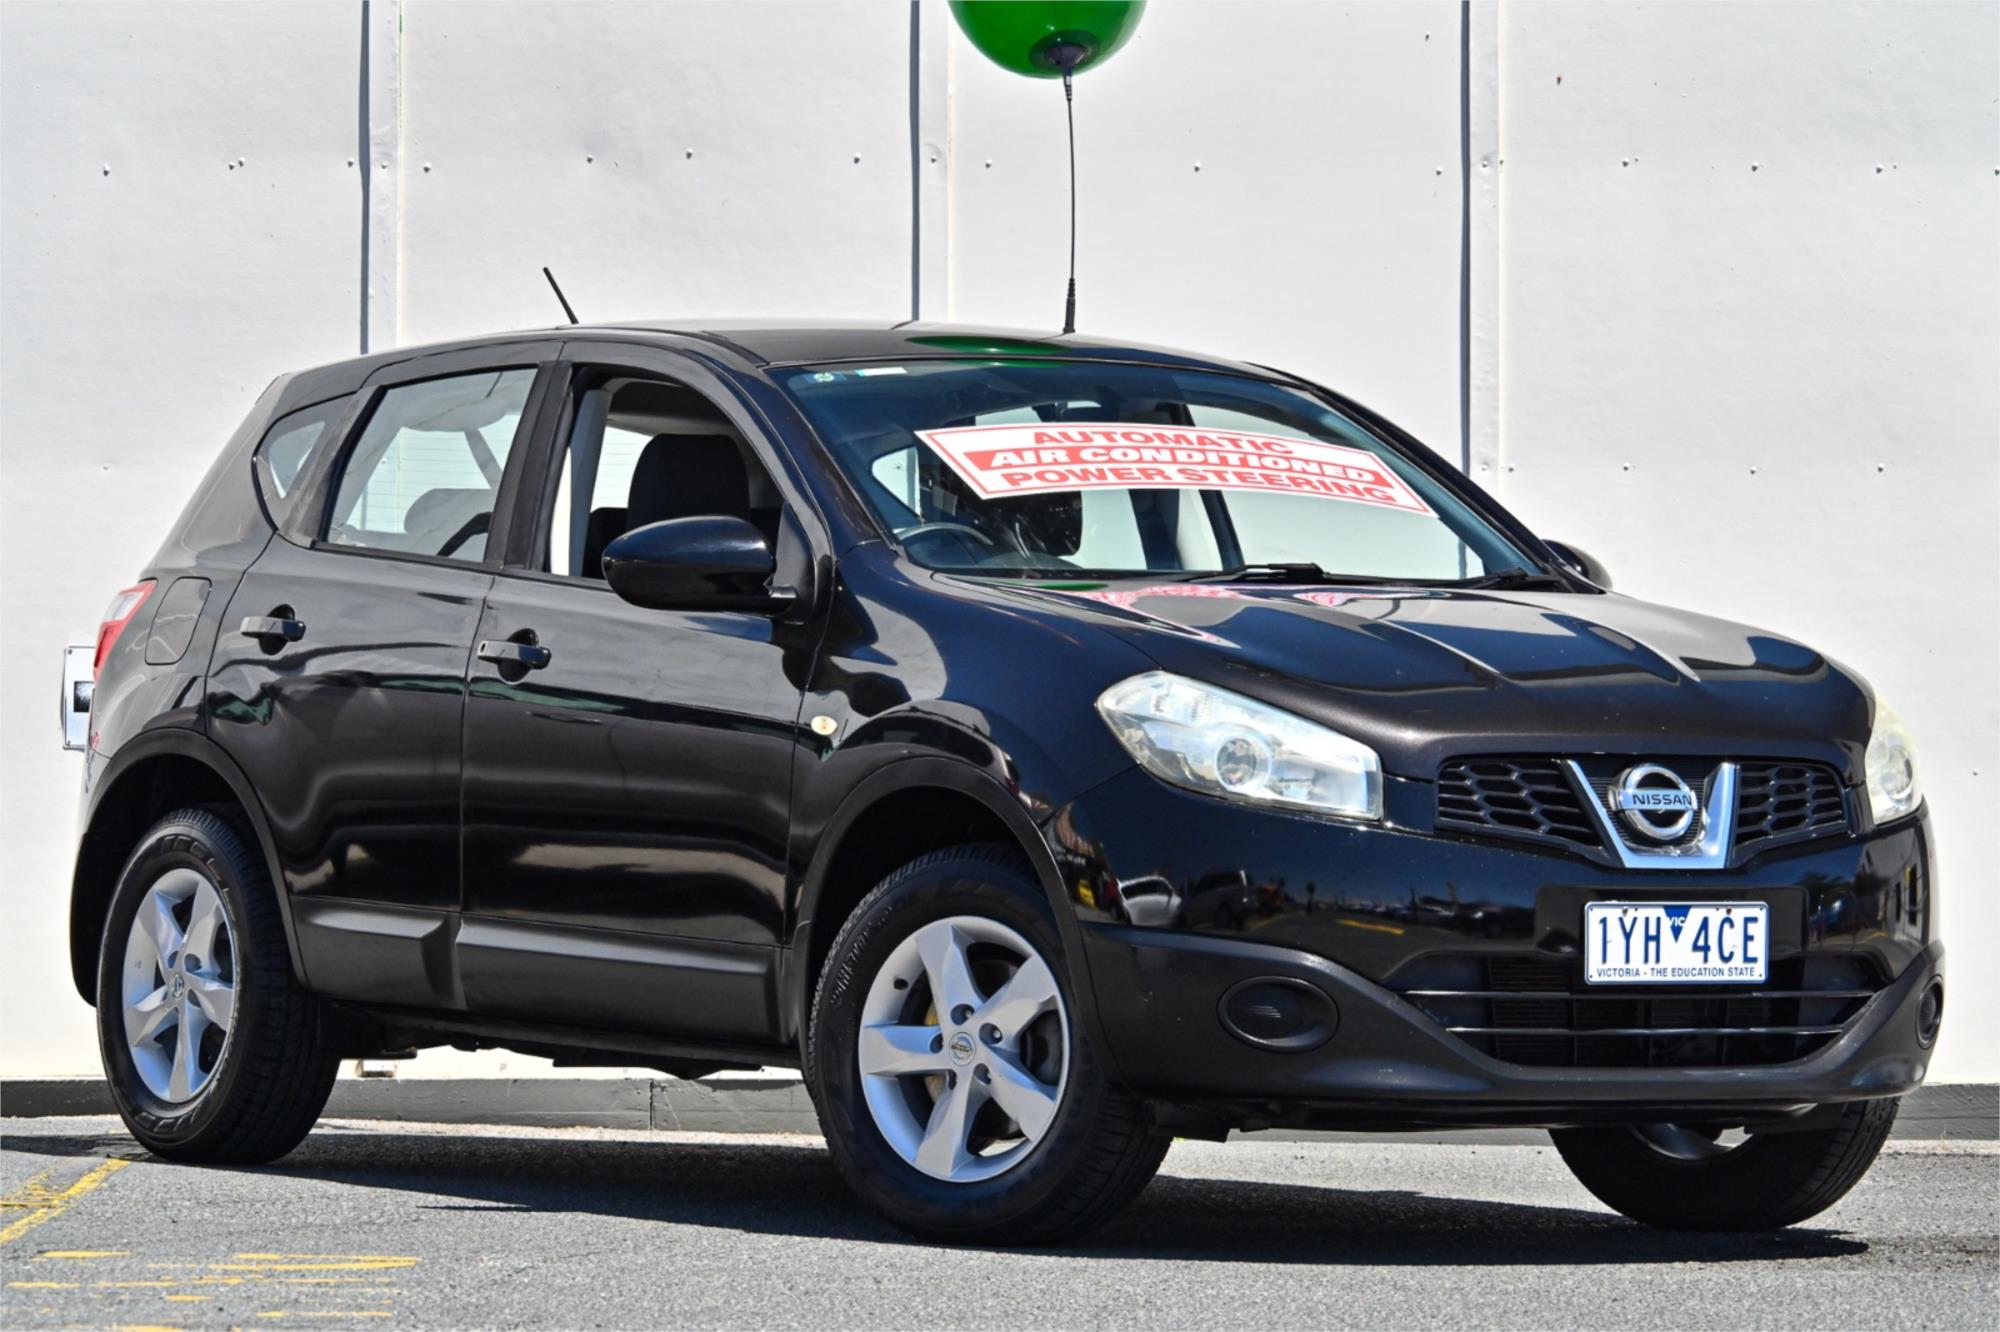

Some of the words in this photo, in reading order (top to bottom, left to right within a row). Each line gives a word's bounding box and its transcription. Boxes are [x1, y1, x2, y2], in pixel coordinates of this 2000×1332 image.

[1034, 430, 1294, 454] AUTOMATIC
[990, 448, 1064, 467] AIR
[1079, 447, 1376, 482] CONDITIONED
[1002, 467, 1173, 486] POWER
[1176, 467, 1398, 503] STEERING
[1632, 794, 1692, 806] NISSAN
[1668, 916, 1686, 927] VIC
[1598, 916, 1661, 965] 1YH
[1691, 916, 1758, 964] 4CE
[1596, 967, 1641, 978] VICTORIA
[1650, 967, 1668, 977] THE
[1670, 967, 1724, 977] EDUCATION
[1727, 966, 1755, 977] STATE
